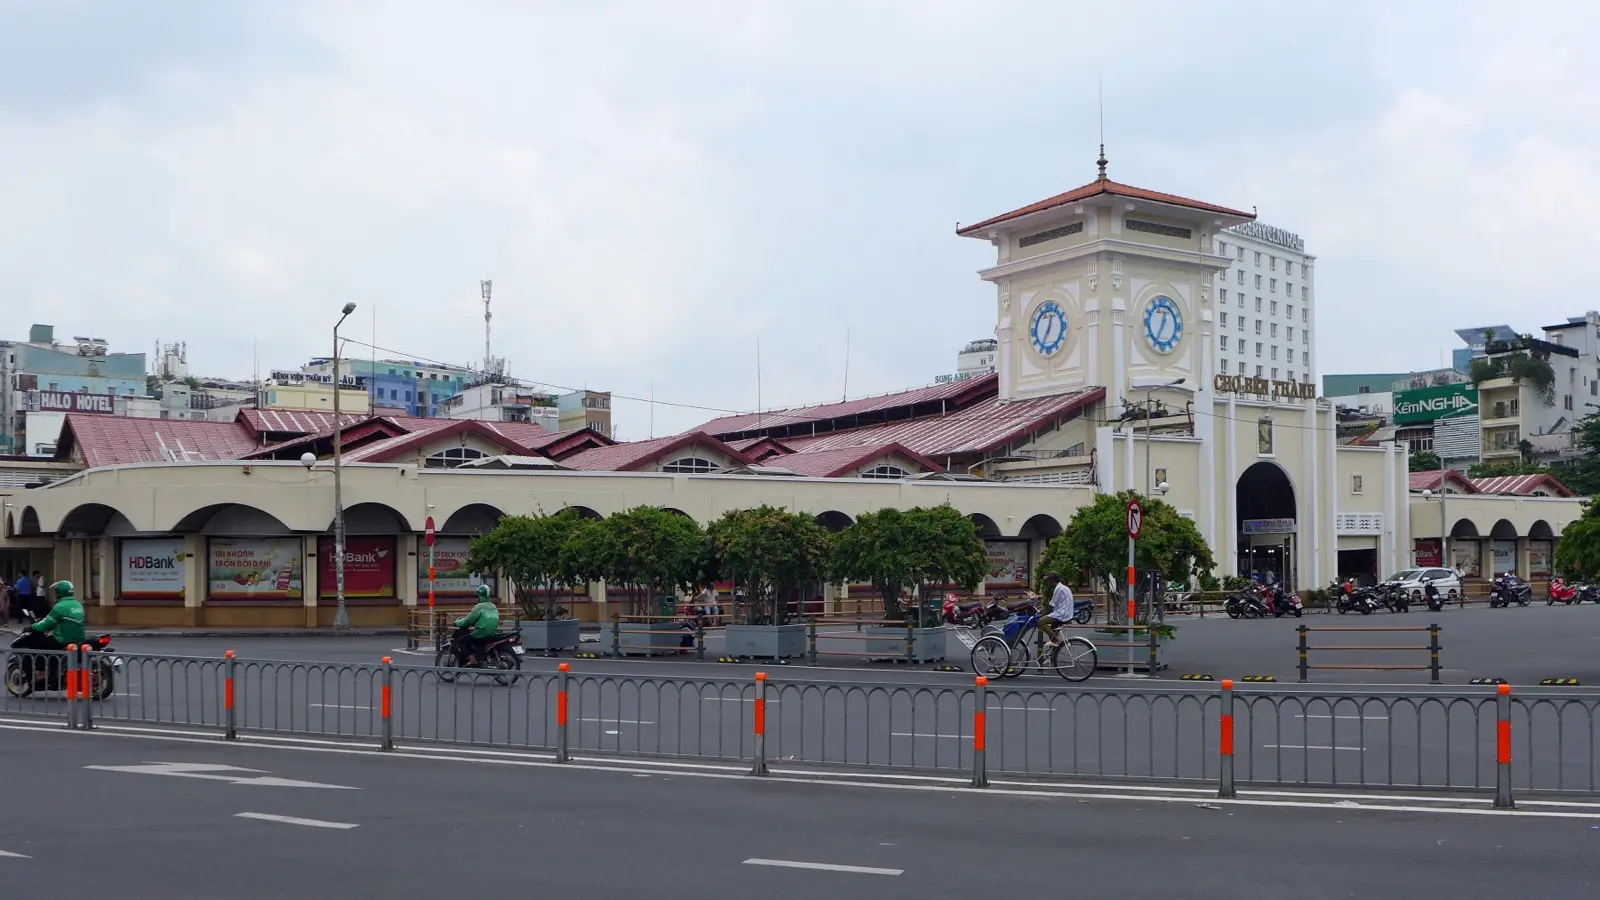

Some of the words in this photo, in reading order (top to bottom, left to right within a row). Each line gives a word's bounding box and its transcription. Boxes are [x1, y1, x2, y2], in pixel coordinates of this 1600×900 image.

[41, 392, 72, 409] HALO
[77, 395, 113, 412] HOTEL
[128, 556, 175, 569] HDBank
[329, 552, 376, 563] HBank
